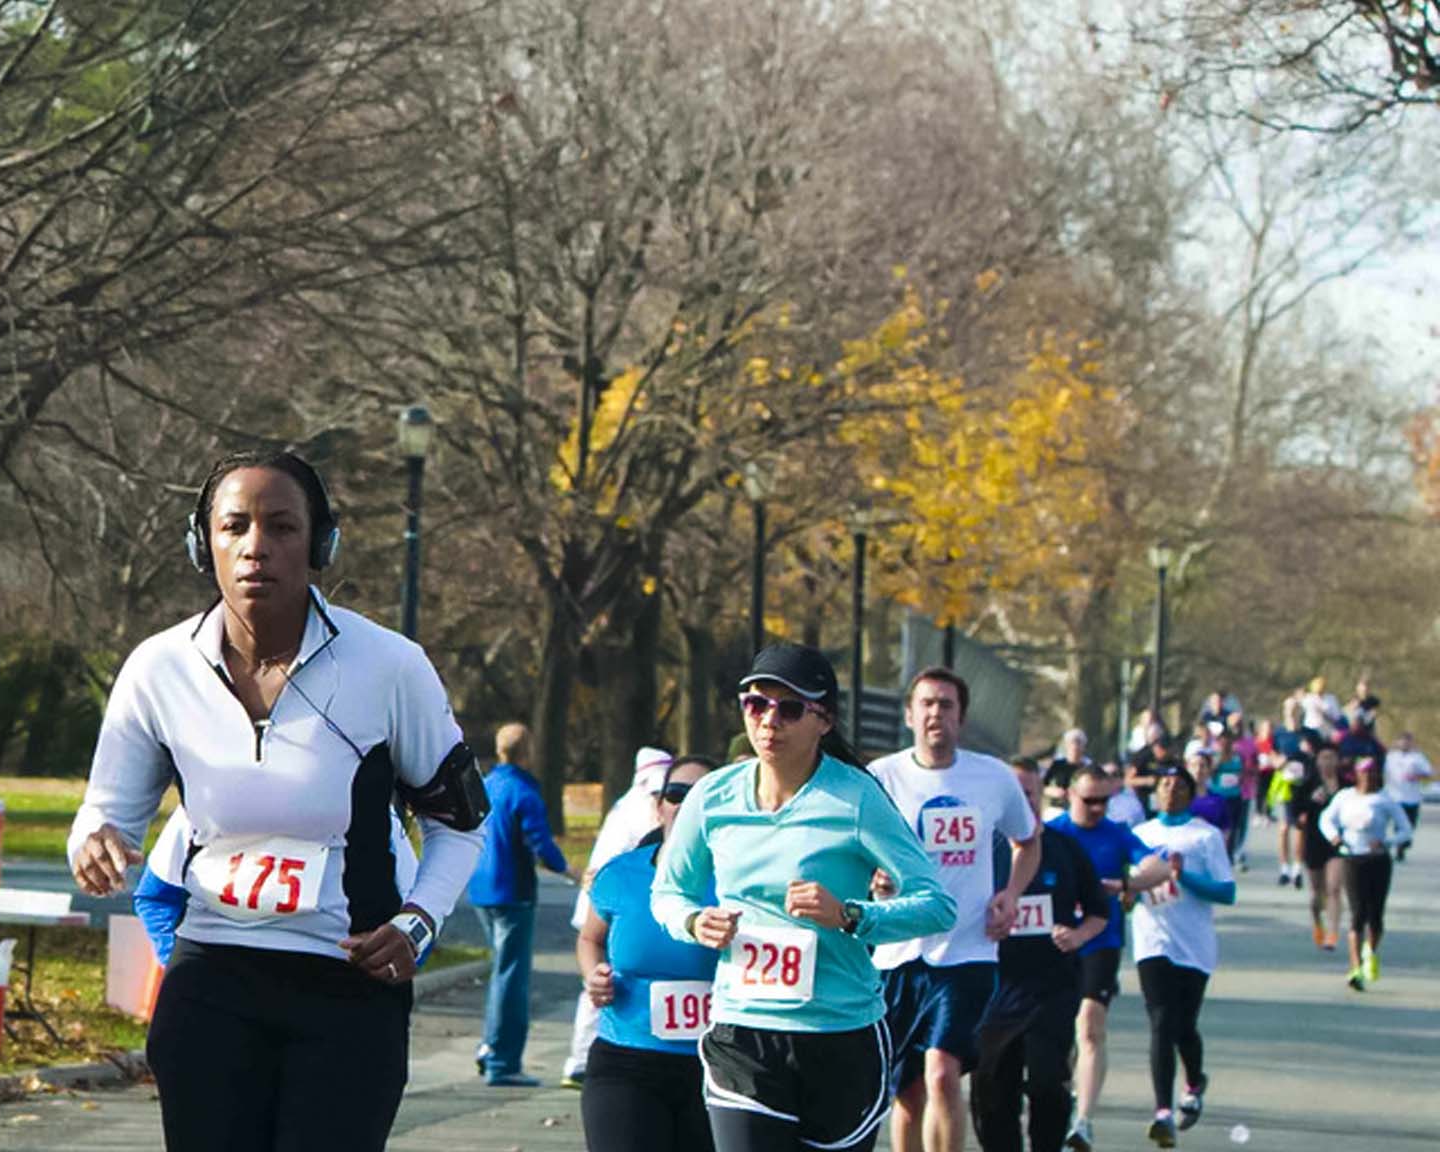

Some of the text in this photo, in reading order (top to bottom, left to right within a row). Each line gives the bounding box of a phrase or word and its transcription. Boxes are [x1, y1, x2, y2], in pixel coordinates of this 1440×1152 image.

[933, 816, 976, 844] 245
[218, 852, 306, 914] 175
[742, 943, 802, 987] 228
